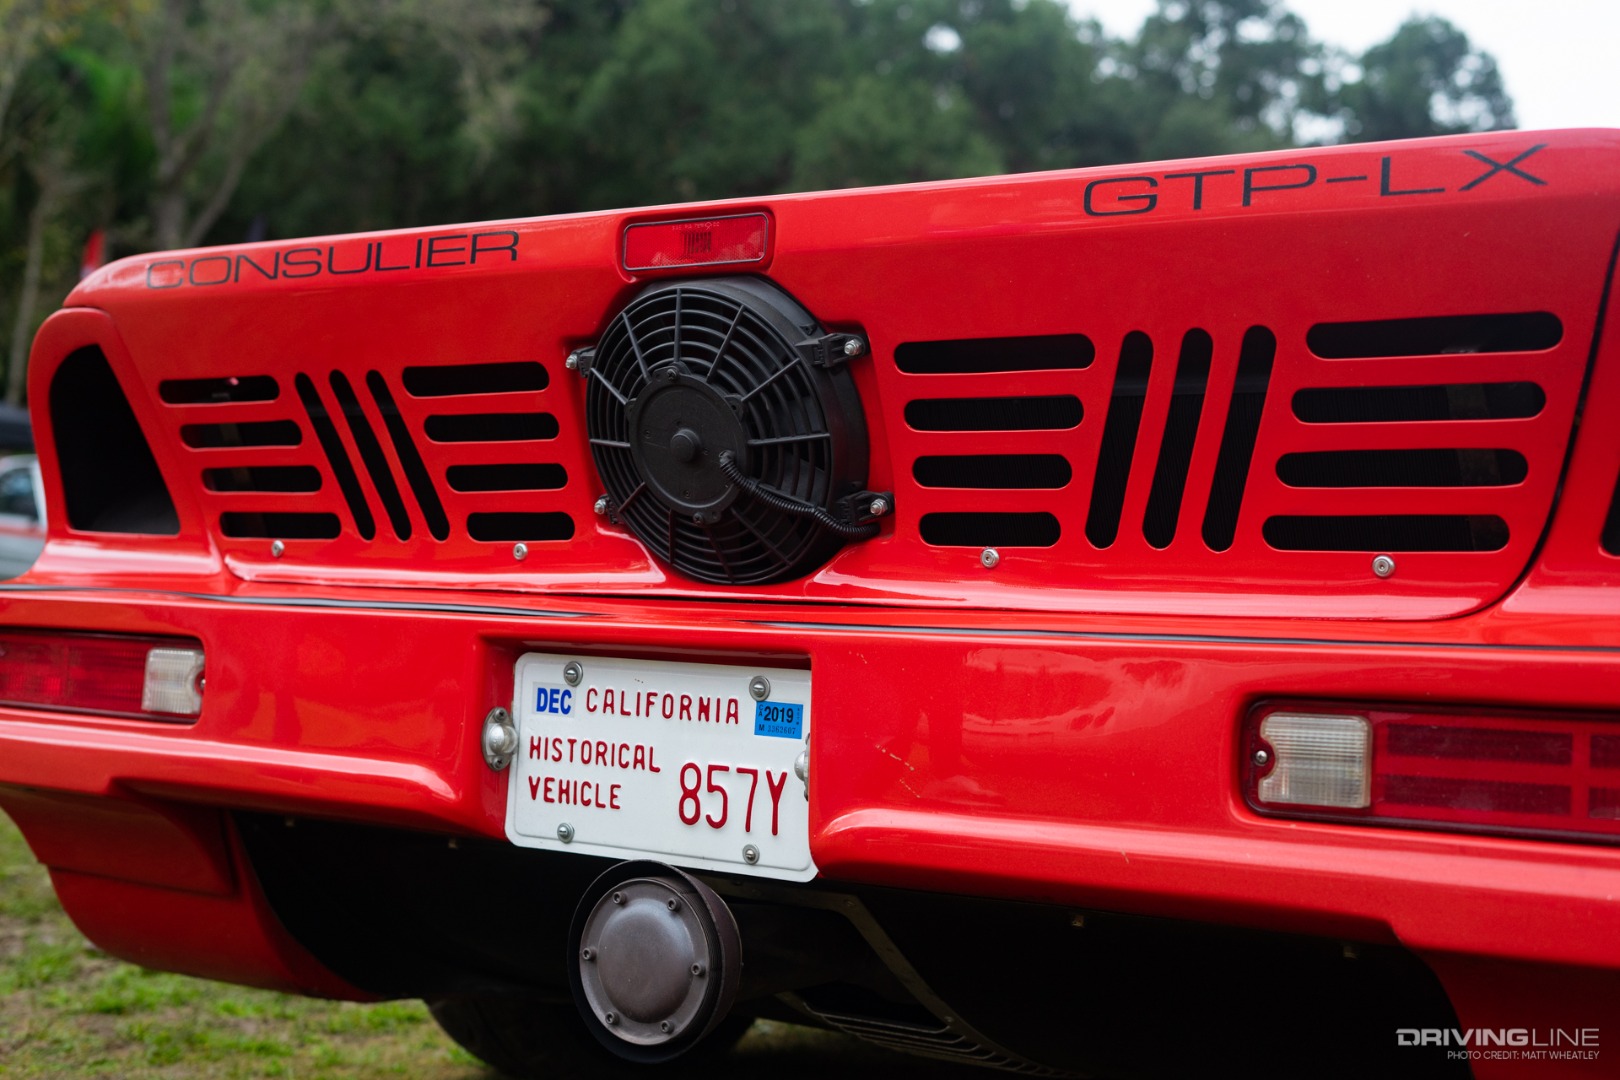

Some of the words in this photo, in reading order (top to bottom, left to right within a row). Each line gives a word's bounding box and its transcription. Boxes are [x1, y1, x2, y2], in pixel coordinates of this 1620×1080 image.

[1083, 144, 1548, 217] GTP-LX
[146, 230, 519, 289] CONSULIER
[536, 687, 572, 715] DEC
[586, 687, 739, 725] CALIFORNIA
[764, 706, 794, 723] 2019
[529, 736, 661, 773] HISTORICAL
[528, 775, 621, 810] VEHICLE
[678, 762, 788, 836] 857Y
